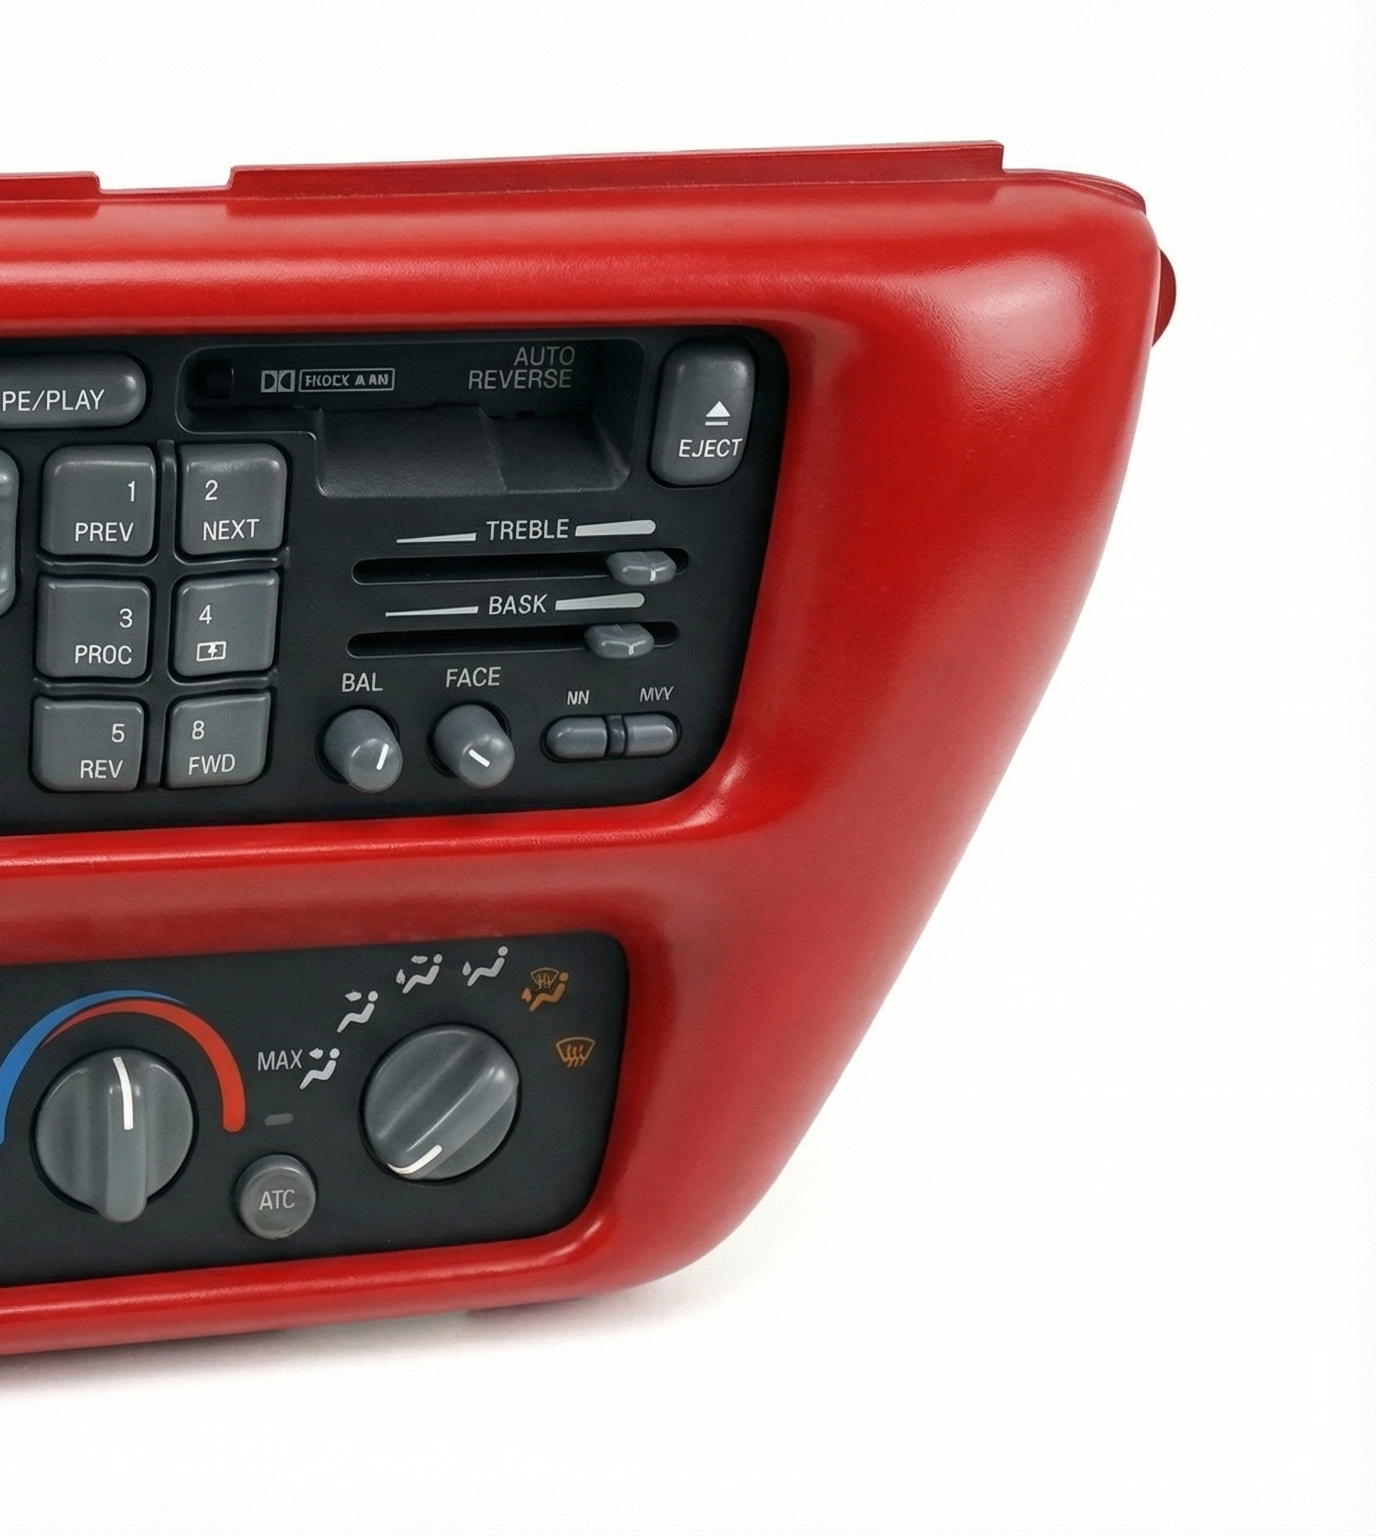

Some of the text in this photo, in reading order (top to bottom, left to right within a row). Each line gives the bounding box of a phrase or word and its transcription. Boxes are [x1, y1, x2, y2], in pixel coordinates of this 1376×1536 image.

[513, 345, 575, 366] AUTO
[468, 368, 572, 390] REVERSE
[678, 437, 743, 458] EJECT
[126, 480, 137, 503] 1
[204, 479, 219, 501] 2
[74, 522, 135, 542] PREV
[202, 518, 261, 541] NEXT
[486, 518, 570, 541] TREBLE
[198, 604, 213, 625] 4
[488, 593, 549, 616] BASK
[118, 608, 133, 629] 3
[74, 644, 133, 665] PROC
[341, 672, 384, 693] BAL
[445, 666, 502, 688] FACE
[111, 723, 125, 743] 5
[191, 720, 206, 740] 8
[80, 759, 124, 779] REV
[188, 753, 237, 776] FWD
[257, 1048, 304, 1072] MAX
[259, 1188, 296, 1211] ATC
